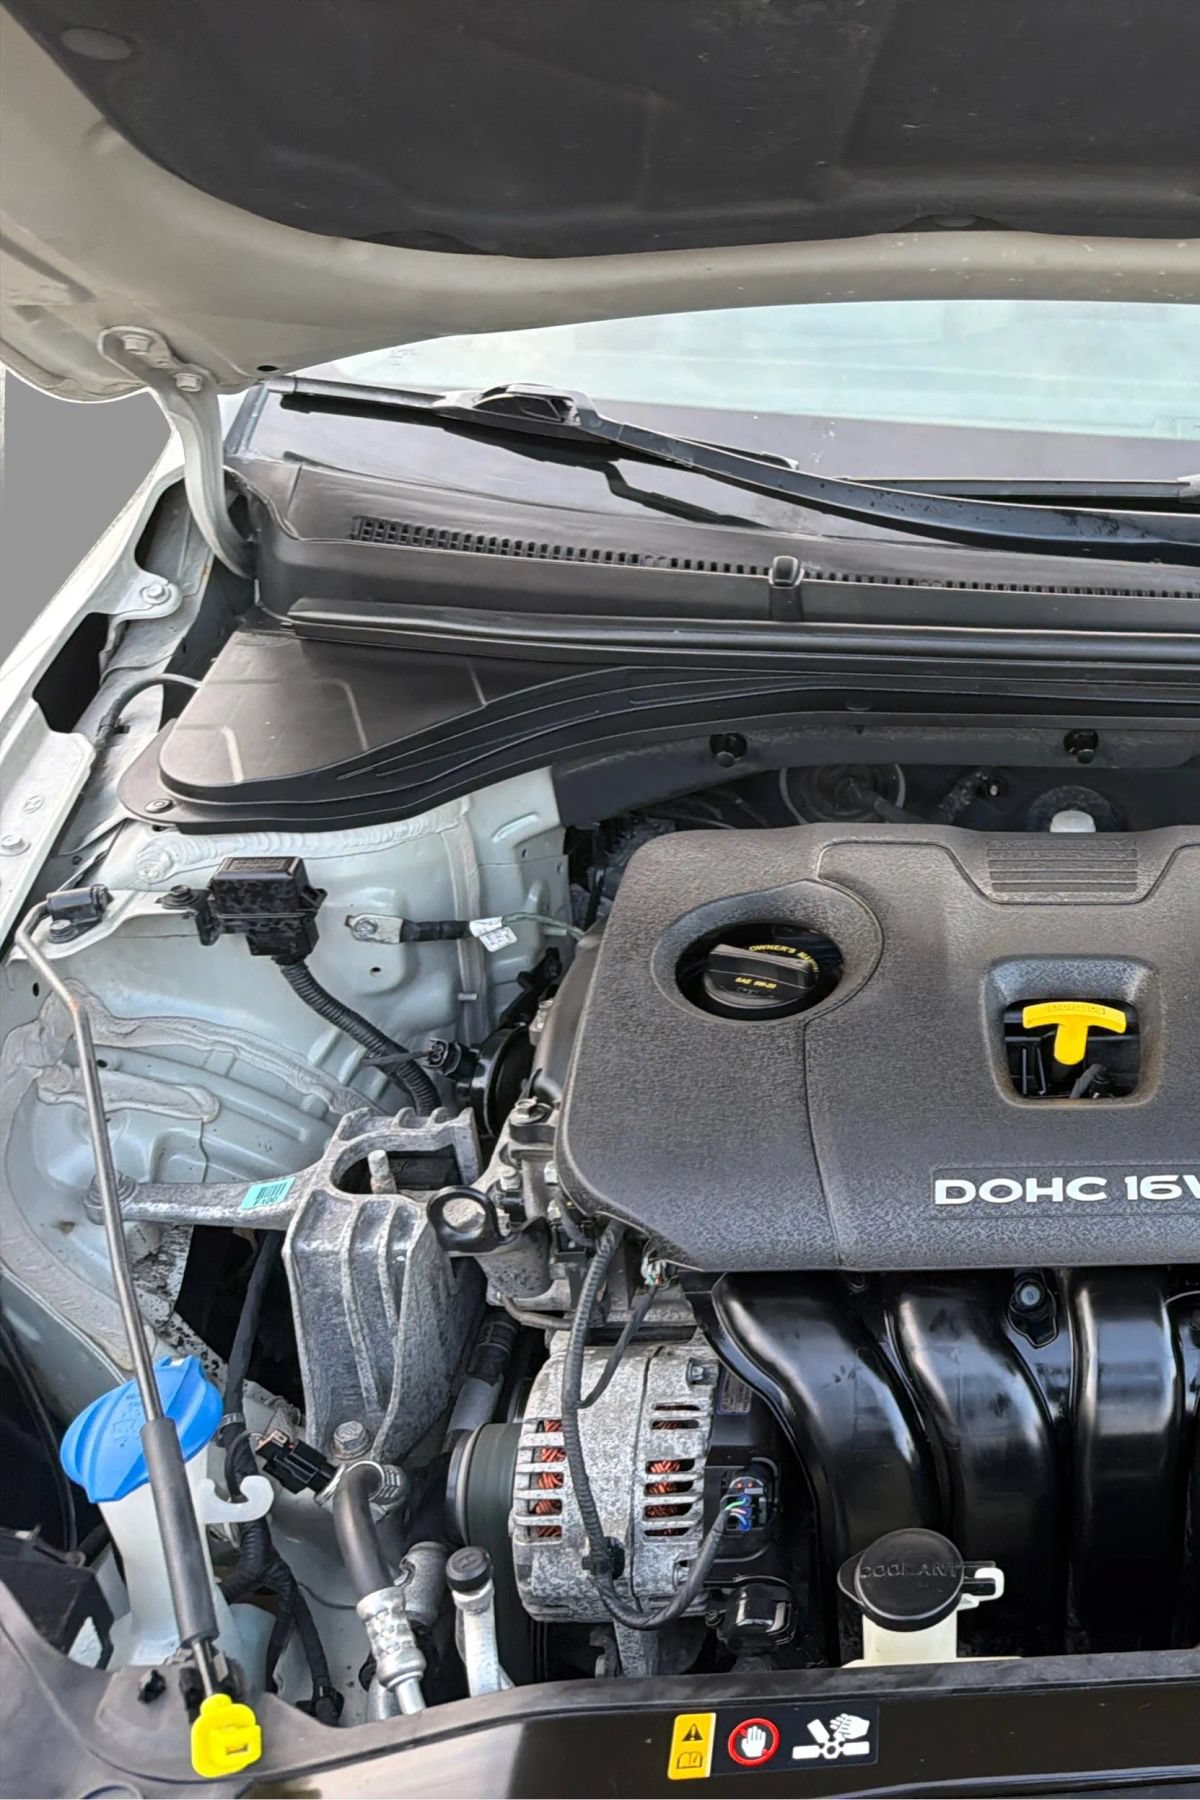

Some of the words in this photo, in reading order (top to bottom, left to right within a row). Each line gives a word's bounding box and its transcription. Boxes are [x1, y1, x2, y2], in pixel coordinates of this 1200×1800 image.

[748, 944, 797, 954] OWNER'S
[934, 1176, 1108, 1205] DOHC
[859, 1562, 960, 1578] COOLANT
